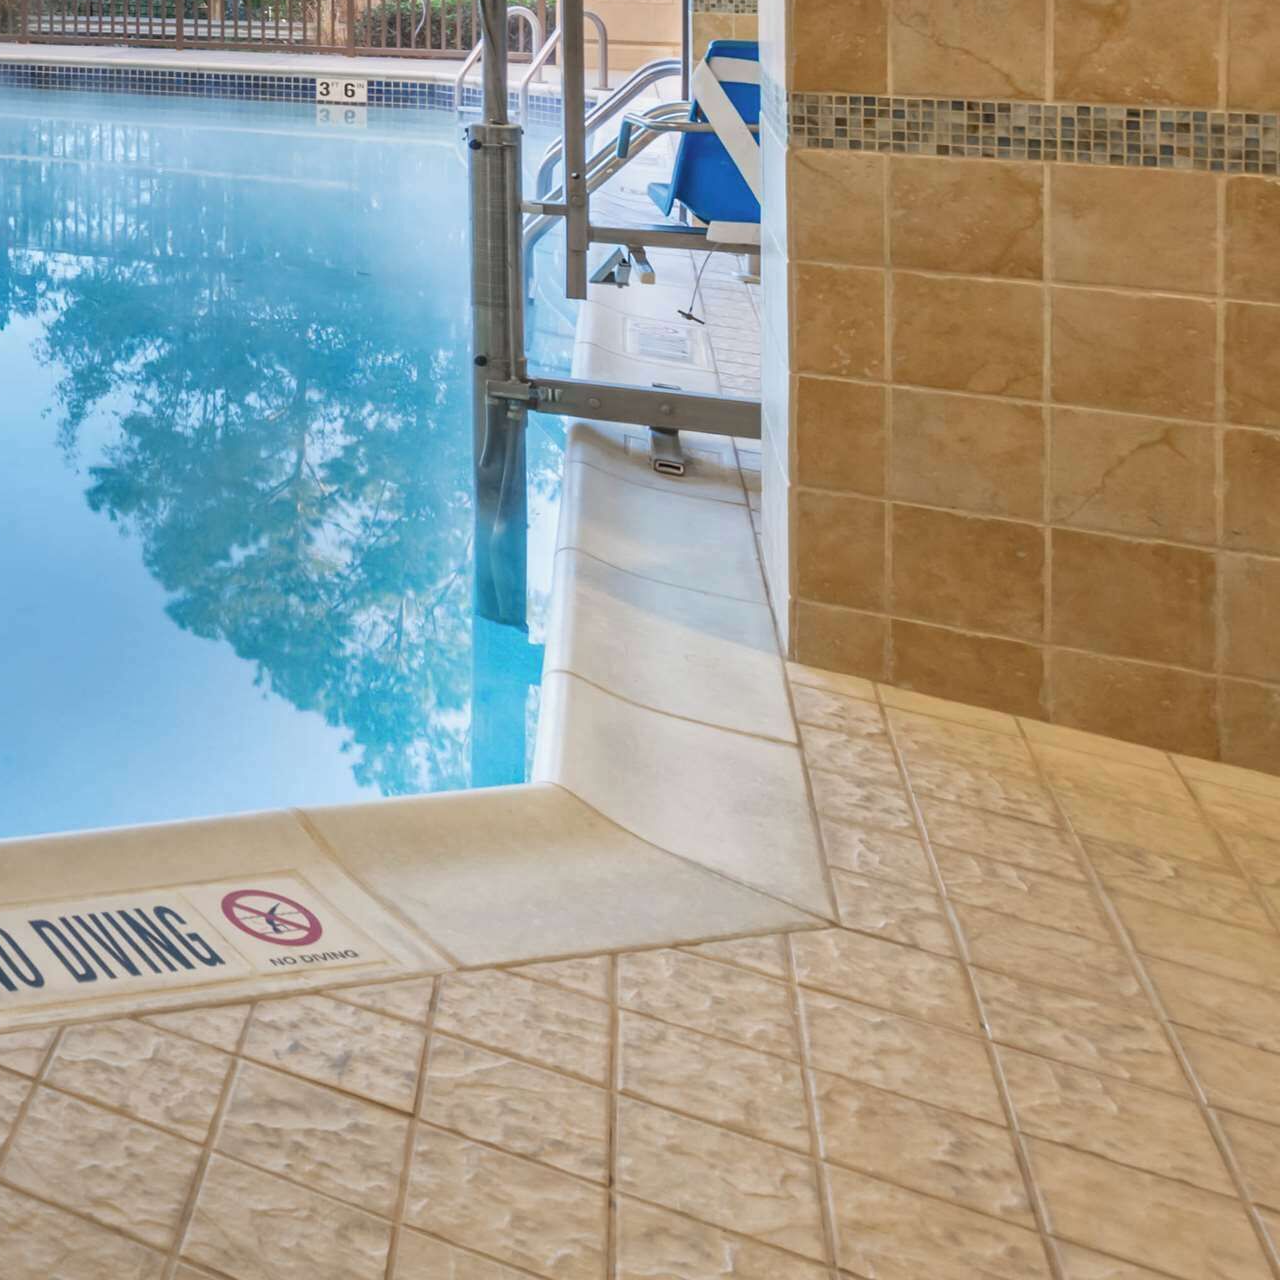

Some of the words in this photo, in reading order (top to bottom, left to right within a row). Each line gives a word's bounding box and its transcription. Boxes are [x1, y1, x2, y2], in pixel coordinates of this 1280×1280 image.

[319, 82, 330, 96] 3
[344, 83, 355, 98] 6
[29, 906, 226, 982] DIVING
[271, 952, 297, 968] NO
[299, 949, 360, 965] DIVING
